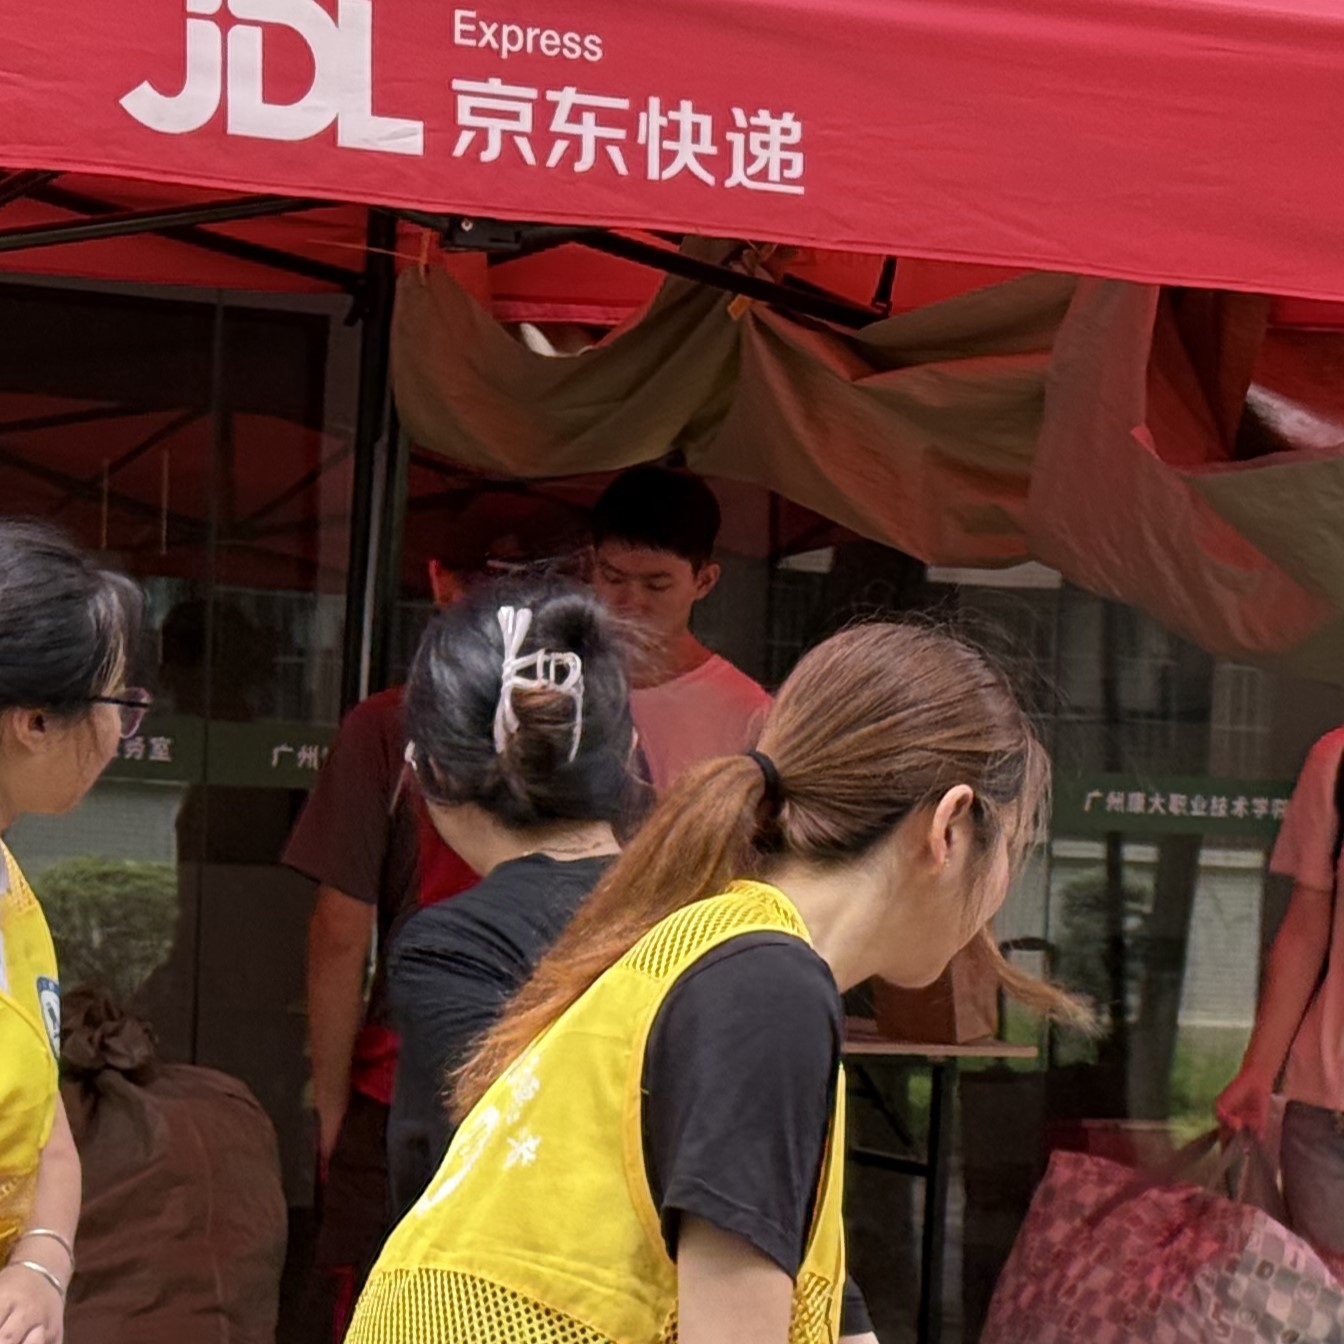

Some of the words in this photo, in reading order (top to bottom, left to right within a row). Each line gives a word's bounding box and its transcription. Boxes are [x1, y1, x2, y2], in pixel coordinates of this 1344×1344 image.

[119, 0, 424, 156] JDL
[454, 10, 604, 62] Express
[451, 78, 806, 196] 京东快递
[271, 743, 329, 770] 广州
